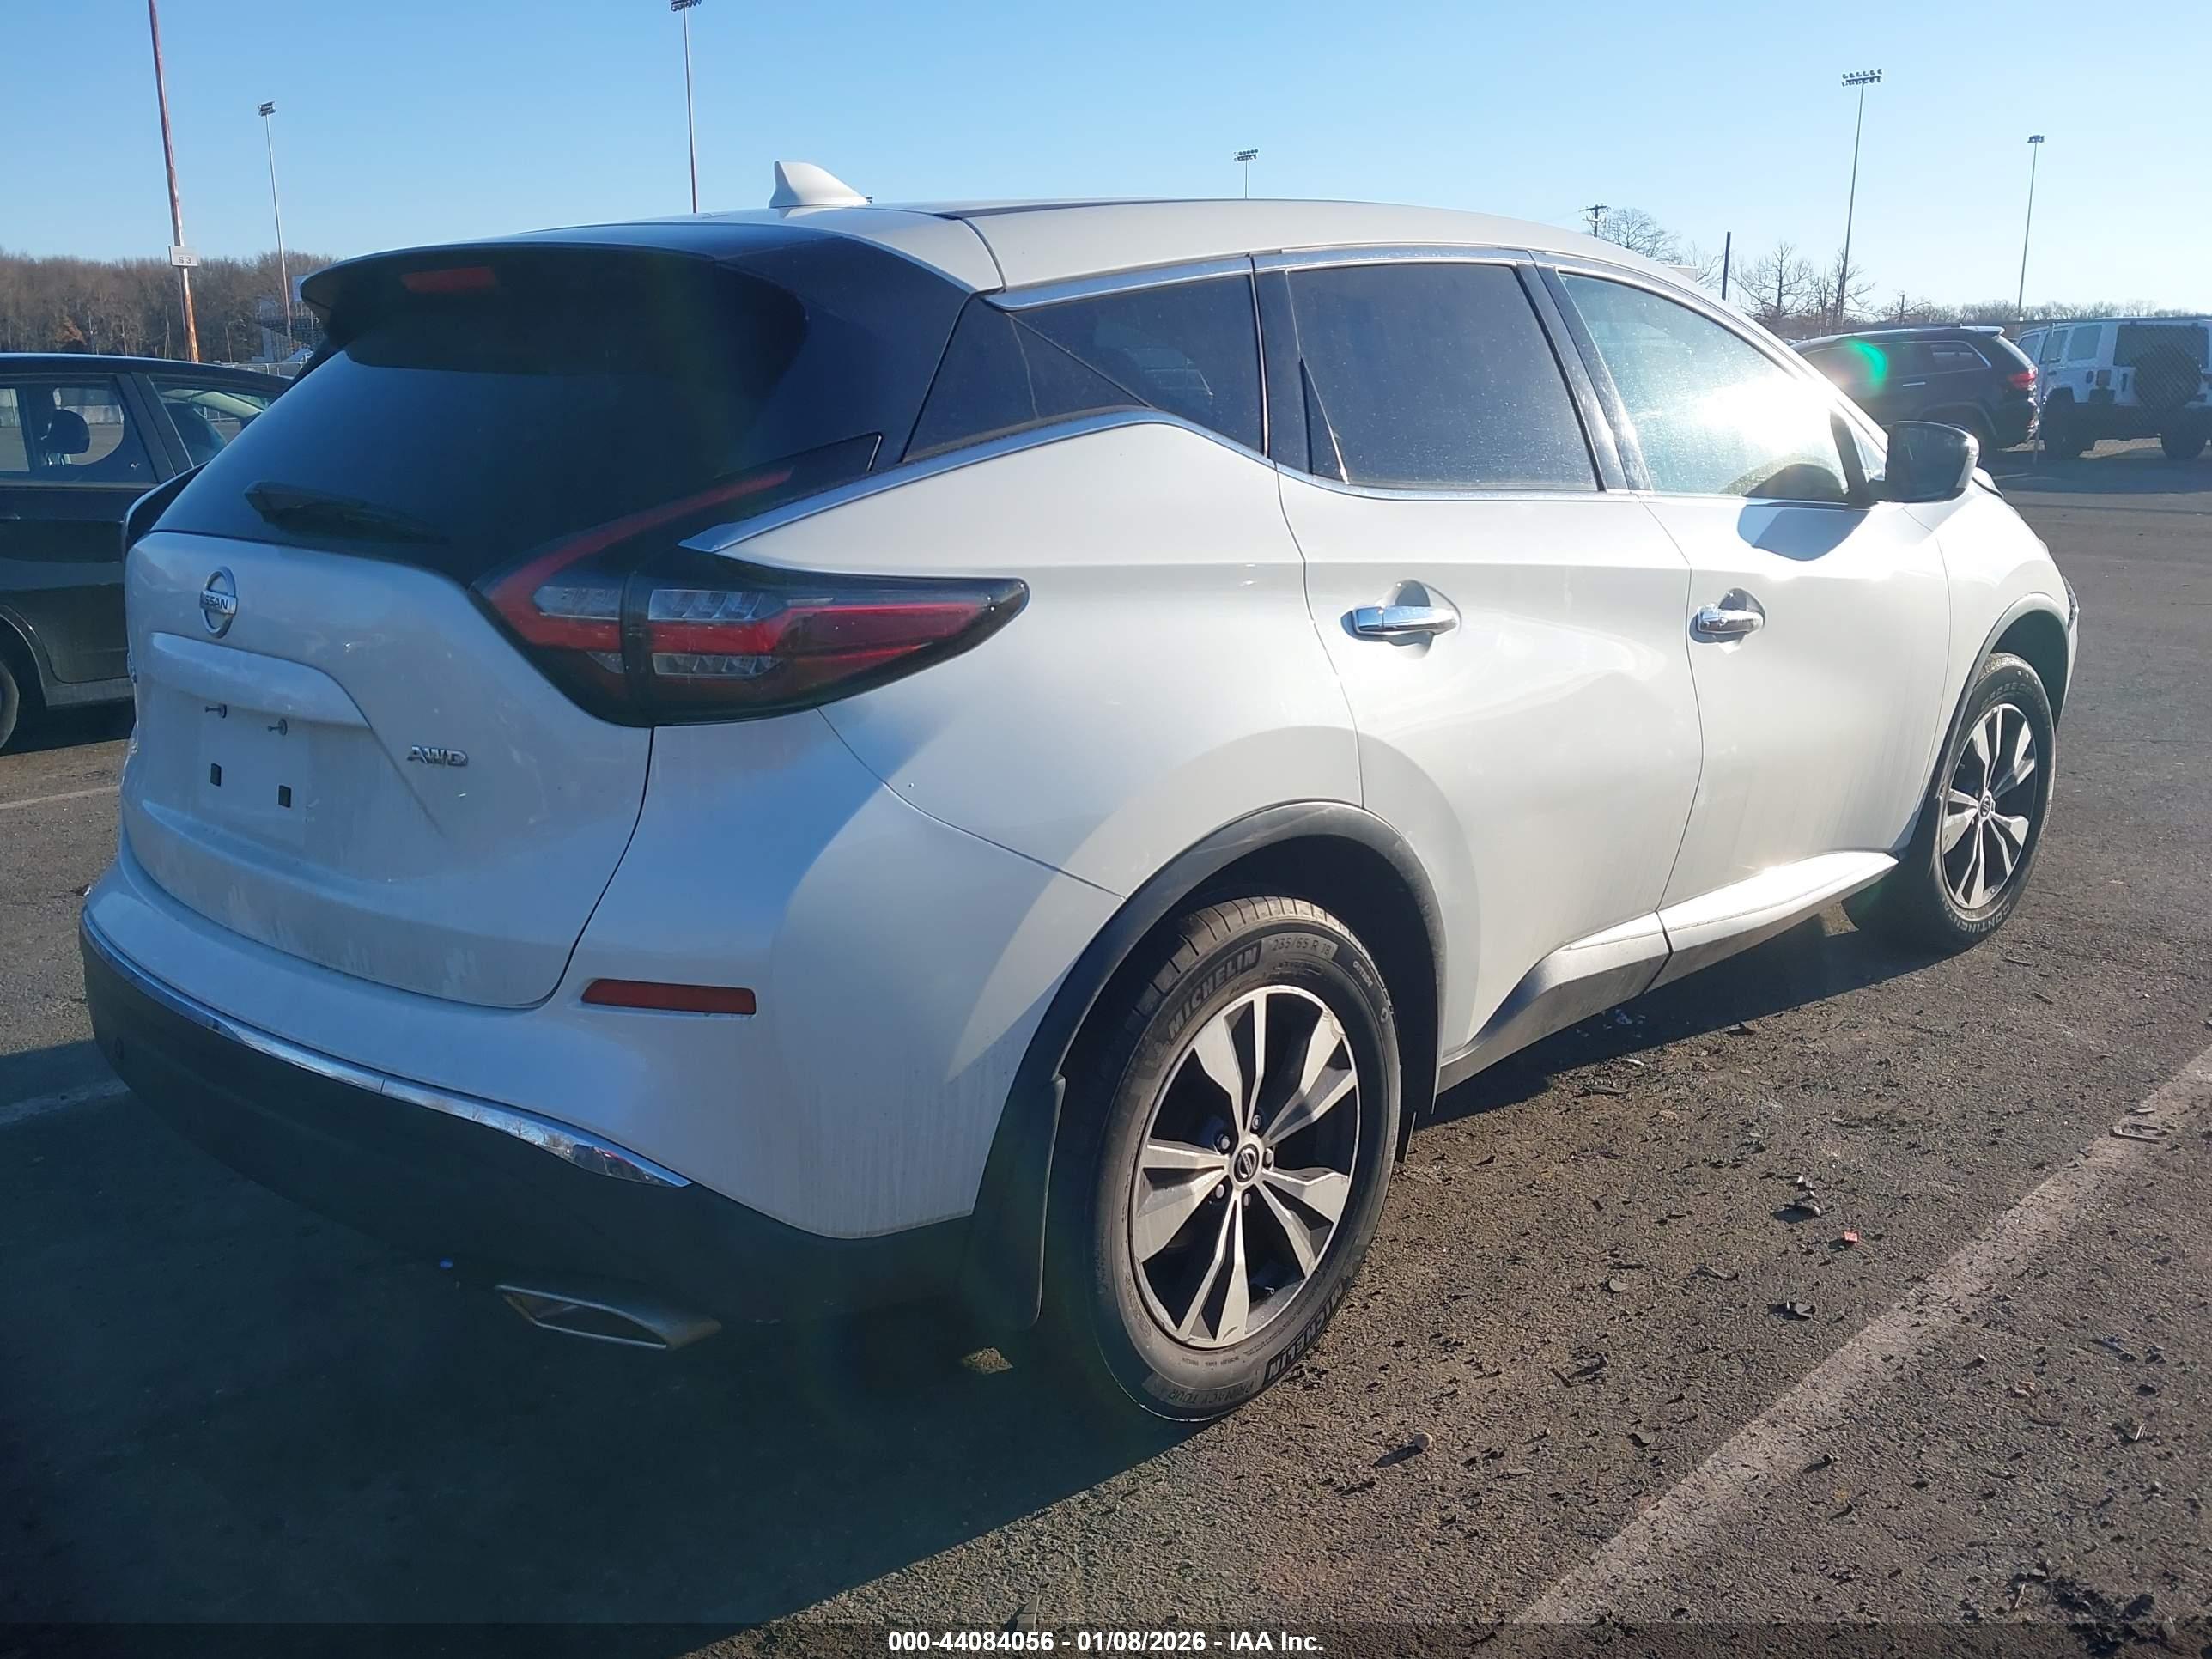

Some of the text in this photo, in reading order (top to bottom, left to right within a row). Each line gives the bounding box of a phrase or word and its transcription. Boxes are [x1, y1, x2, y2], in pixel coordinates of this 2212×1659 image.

[407, 744, 469, 766] AWD
[1272, 935, 1310, 951] 235/65
[1311, 939, 1320, 951] R
[1168, 945, 1259, 1040] MICHELIN
[1267, 1280, 1344, 1380] MICHELIN
[1168, 1389, 1200, 1405] TOUR
